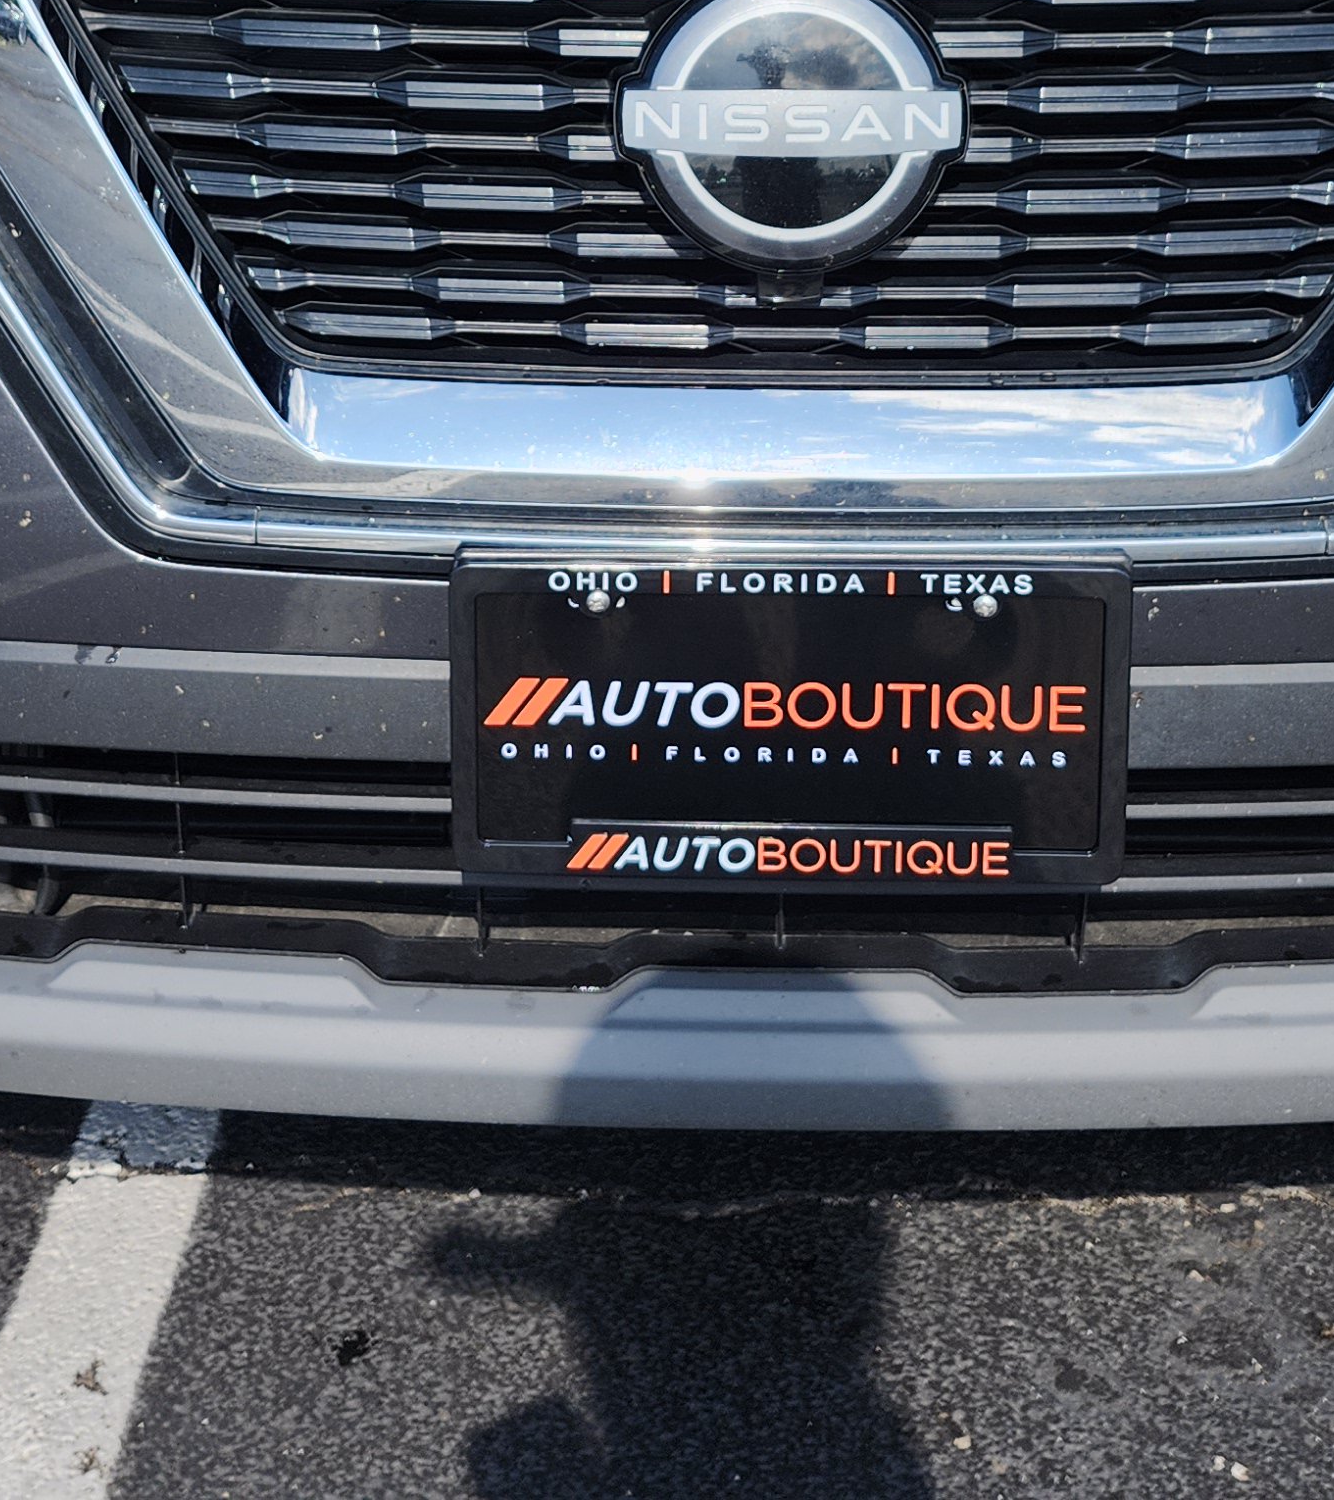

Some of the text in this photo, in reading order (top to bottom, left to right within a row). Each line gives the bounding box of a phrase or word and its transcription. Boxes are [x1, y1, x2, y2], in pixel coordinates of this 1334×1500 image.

[634, 101, 950, 143] NISSAN
[548, 571, 1034, 595] OHIO FLORIDA TEXAS
[547, 679, 1087, 732] AUTOBOUTIQUE
[500, 742, 1068, 768] OHIO FLORIDA TEXAS
[613, 836, 1010, 876] AUTOBOUTIQUE
